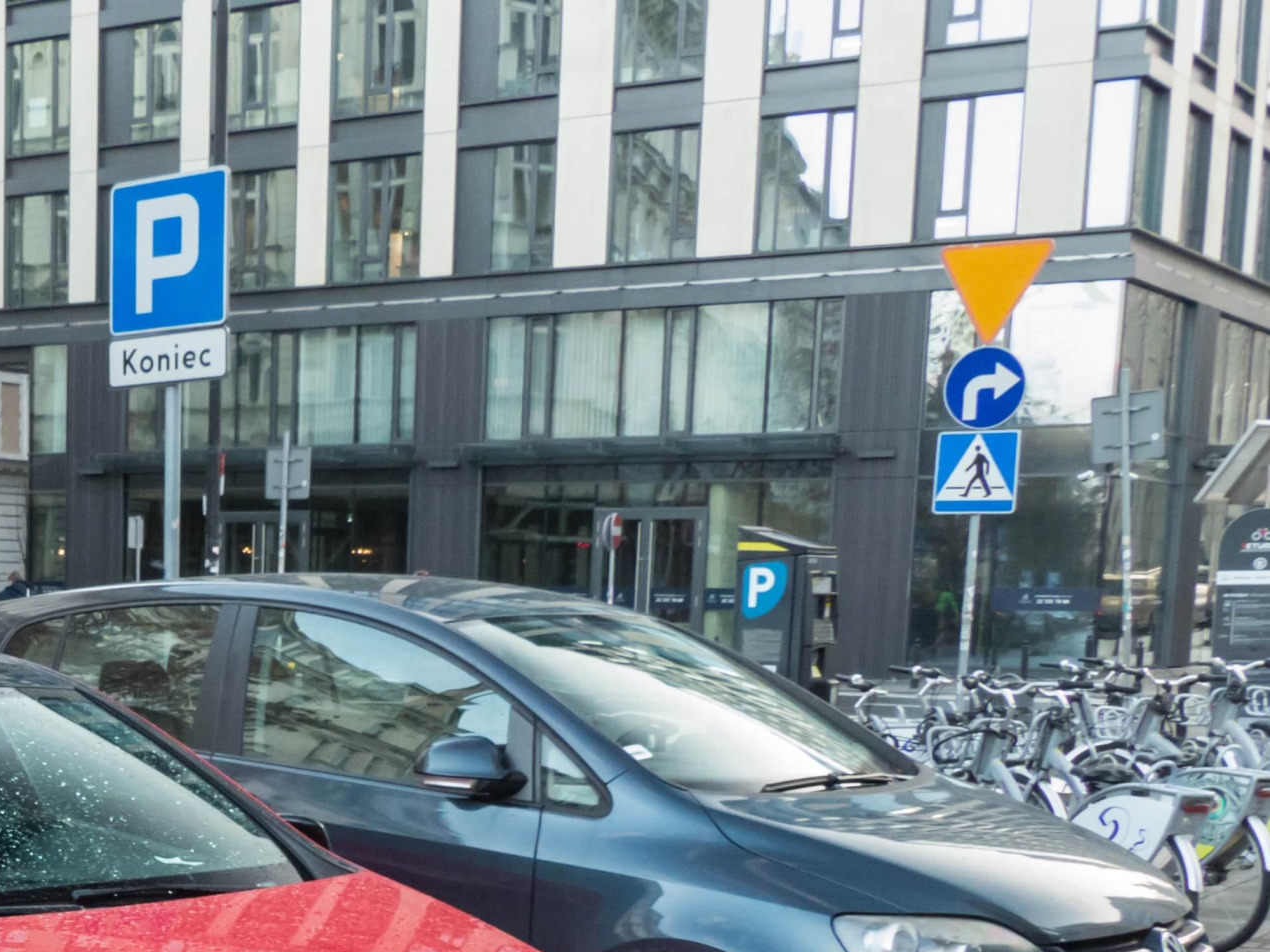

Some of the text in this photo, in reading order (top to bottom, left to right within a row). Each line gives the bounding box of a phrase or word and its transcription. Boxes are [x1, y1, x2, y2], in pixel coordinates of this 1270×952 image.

[136, 193, 200, 315] P
[122, 344, 211, 376] Koniec
[748, 566, 776, 608] P
